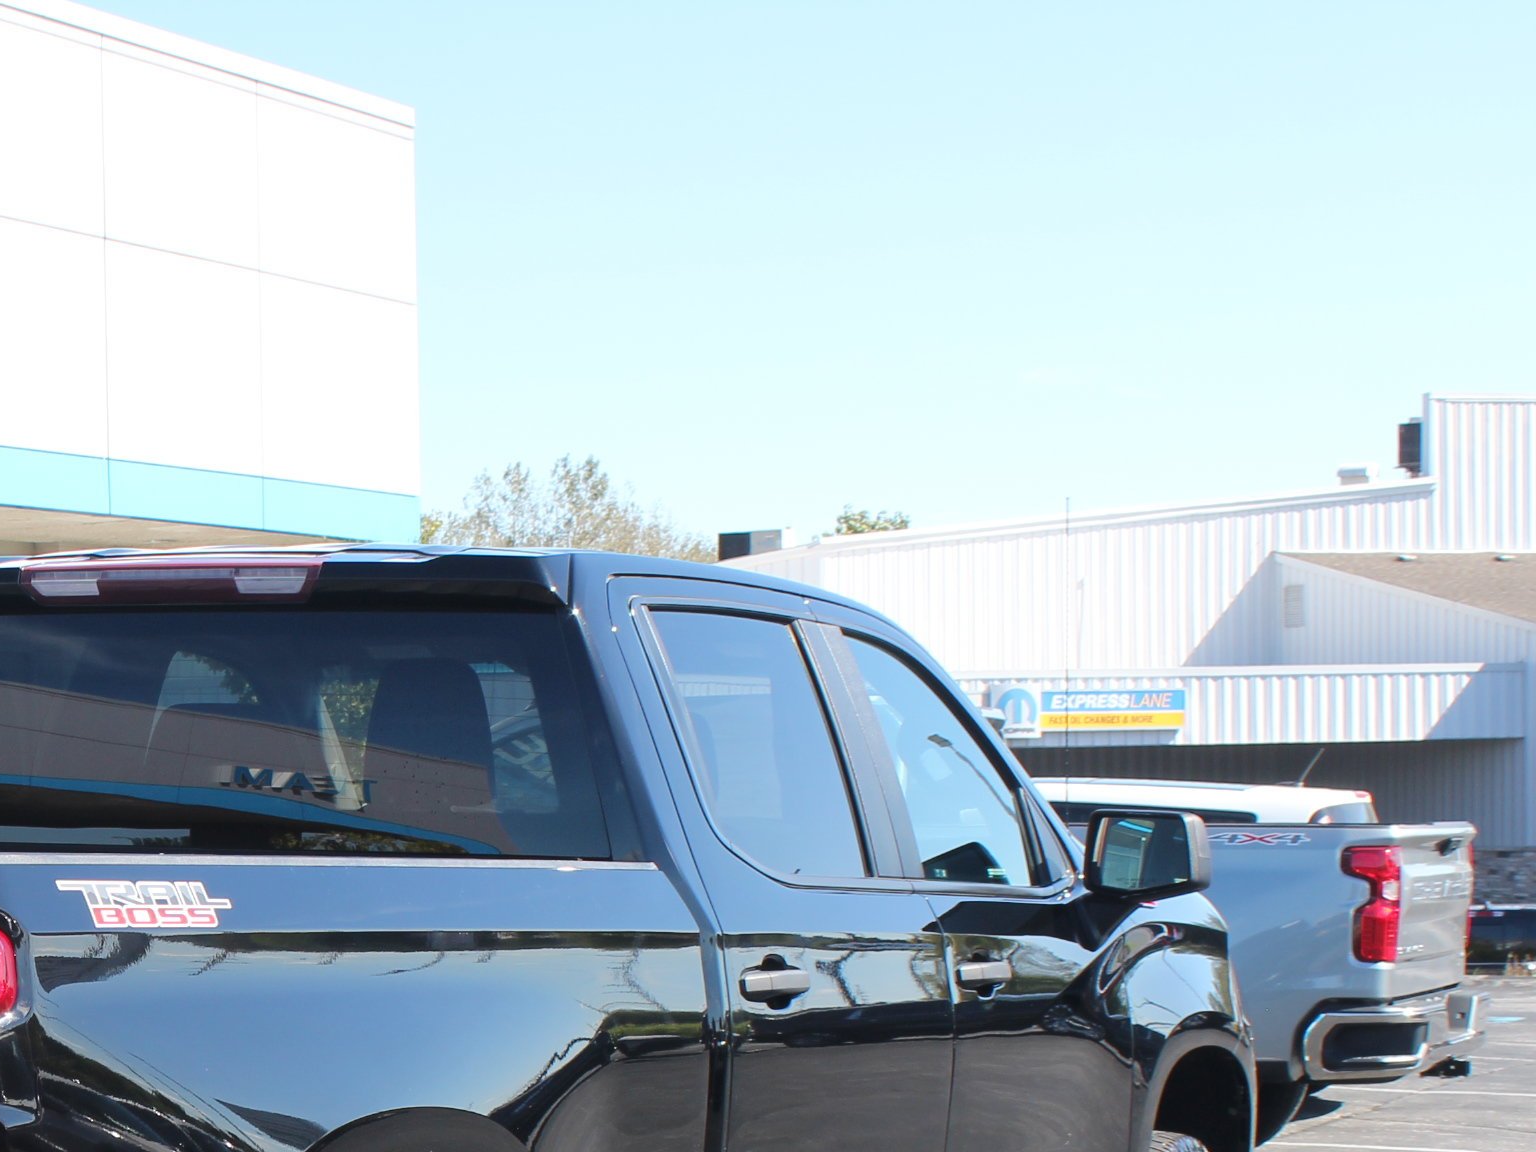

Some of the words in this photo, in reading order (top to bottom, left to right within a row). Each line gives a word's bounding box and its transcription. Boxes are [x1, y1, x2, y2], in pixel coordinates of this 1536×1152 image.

[1131, 715, 1153, 724] MORE
[55, 880, 233, 910] TRAIL
[91, 906, 219, 929] BOSS
